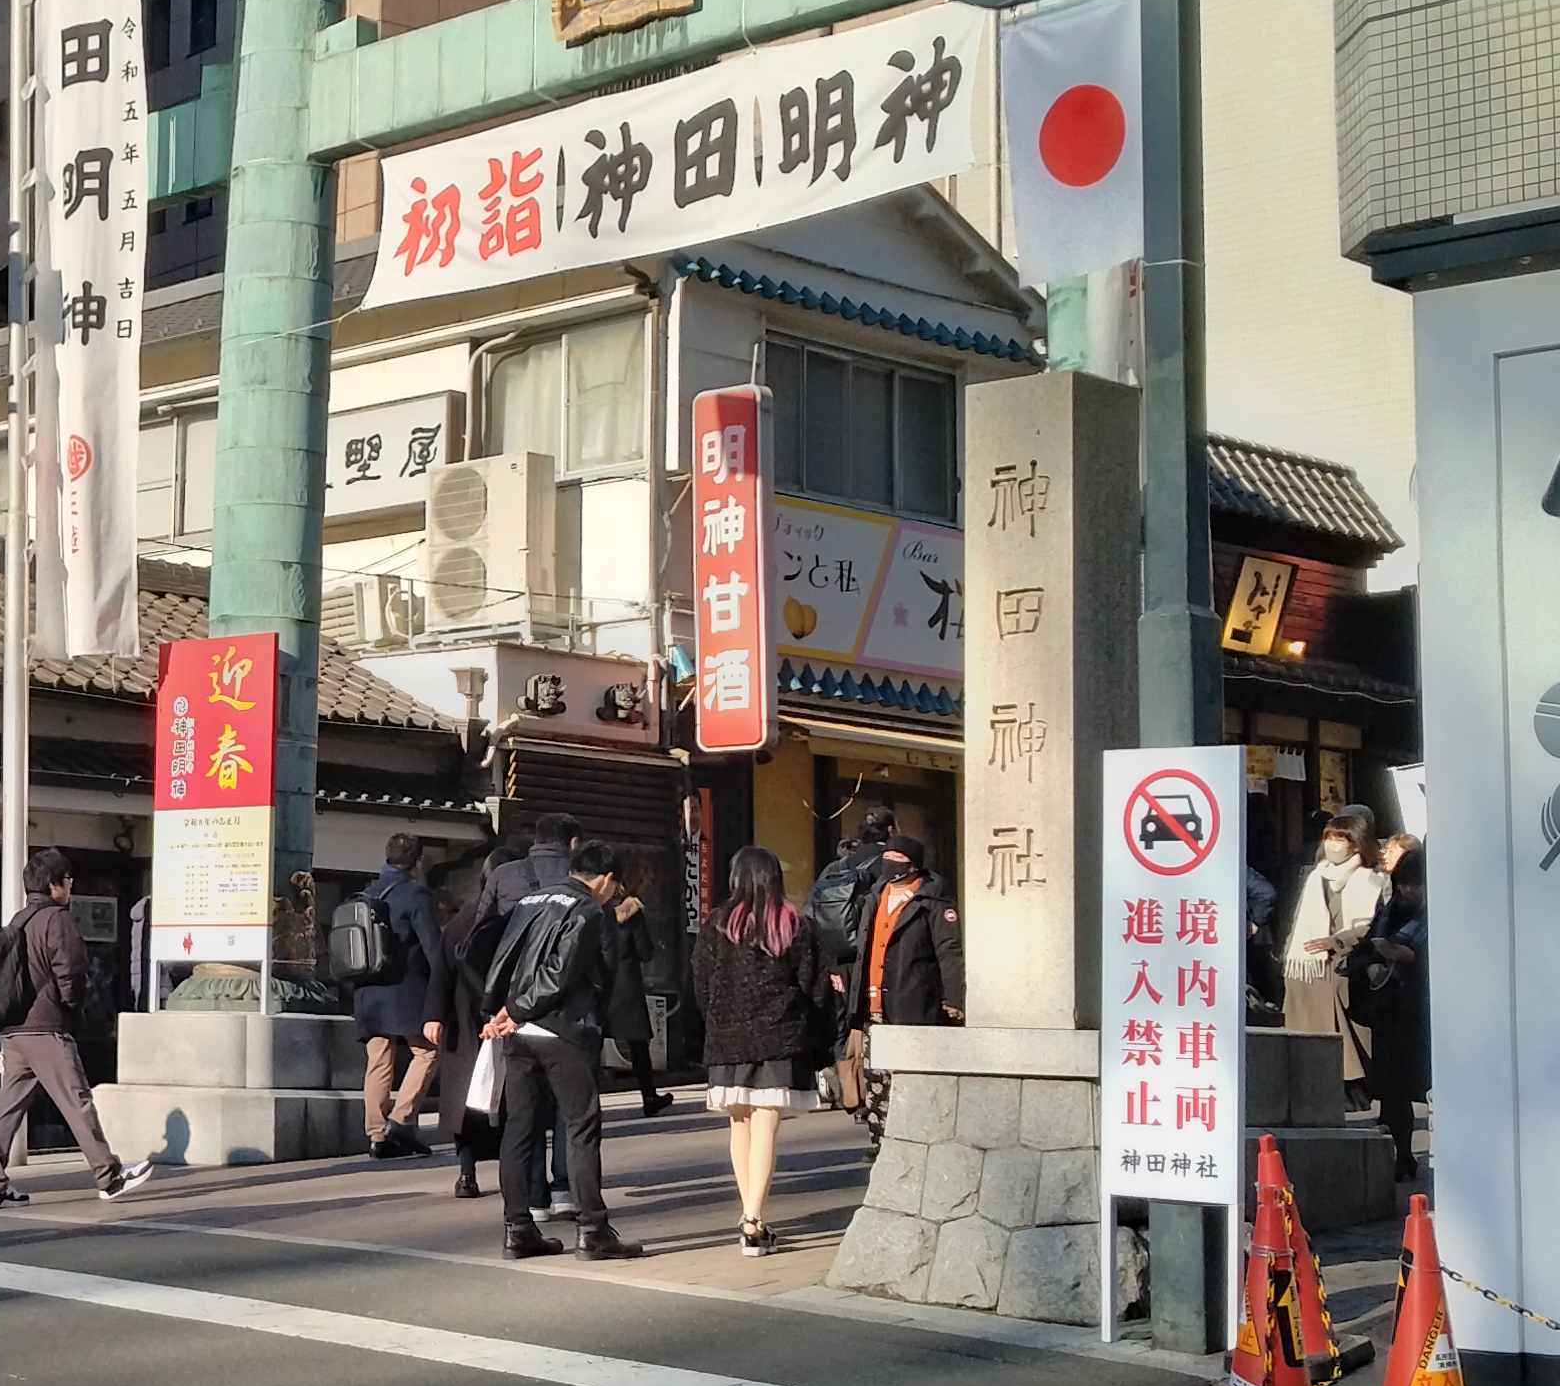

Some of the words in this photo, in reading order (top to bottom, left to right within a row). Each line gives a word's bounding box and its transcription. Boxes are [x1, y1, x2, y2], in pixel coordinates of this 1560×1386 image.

[115, 16, 140, 341] 令和五年五月吉日
[702, 424, 751, 712] 明神甘酒
[903, 540, 940, 564] Bar
[205, 646, 258, 790] 迎春
[987, 459, 1051, 896] 神田神社
[1121, 897, 1165, 1128] 進入禁止
[1175, 897, 1220, 1133] 境内車両
[1120, 1148, 1219, 1179] 神田神社
[1419, 1311, 1444, 1370] DANGER
